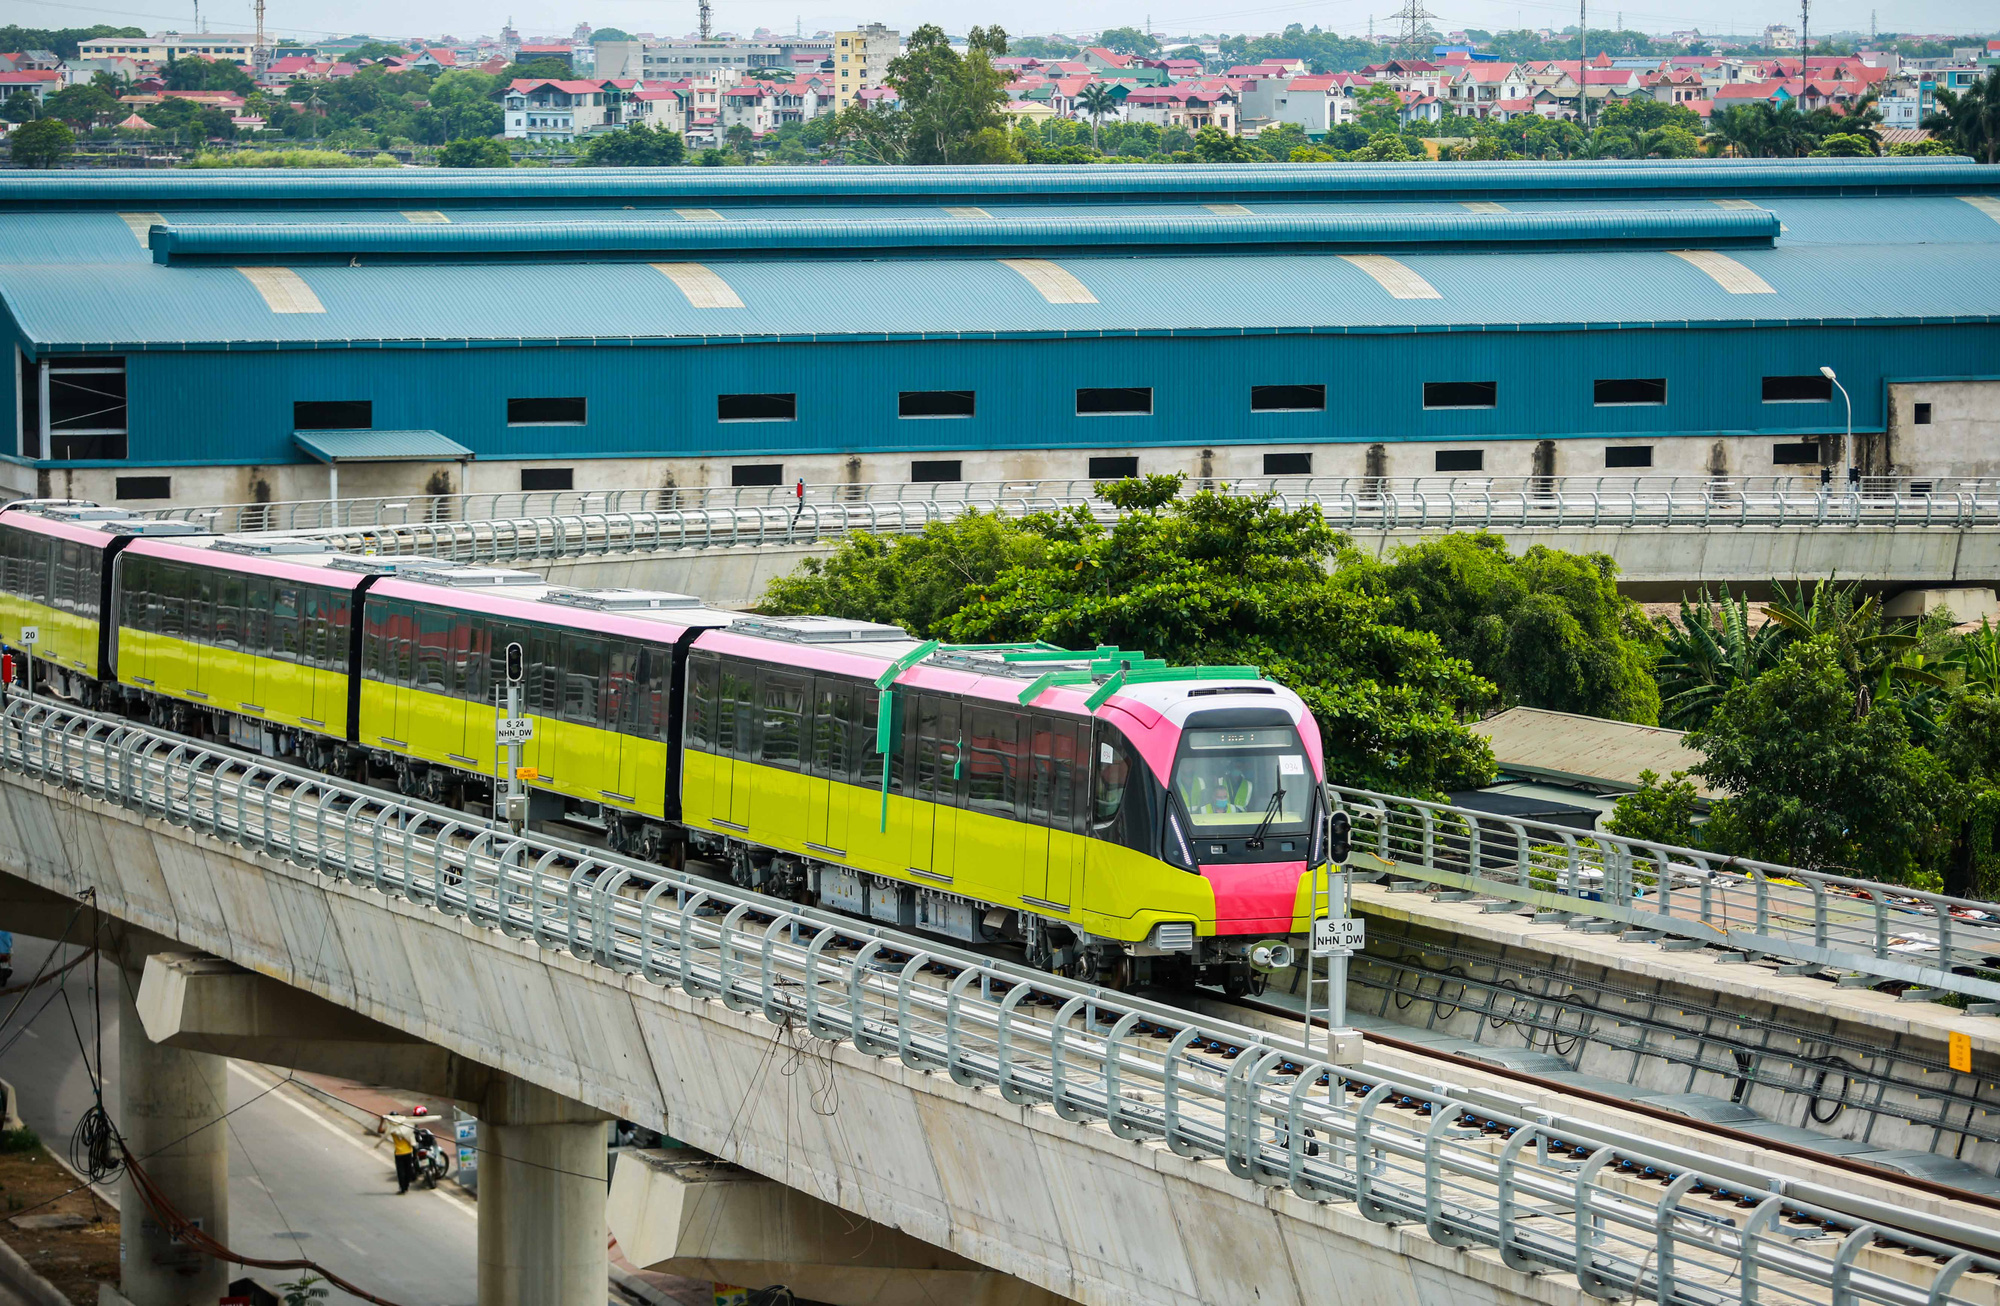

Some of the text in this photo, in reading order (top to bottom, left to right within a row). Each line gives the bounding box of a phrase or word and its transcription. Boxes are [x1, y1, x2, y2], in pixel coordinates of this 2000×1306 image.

[25, 631, 35, 639] 20
[506, 720, 524, 729] S_24
[498, 729, 532, 738] NHN_DW
[1328, 922, 1353, 934] S_10
[1317, 935, 1363, 947] NHN_DW
